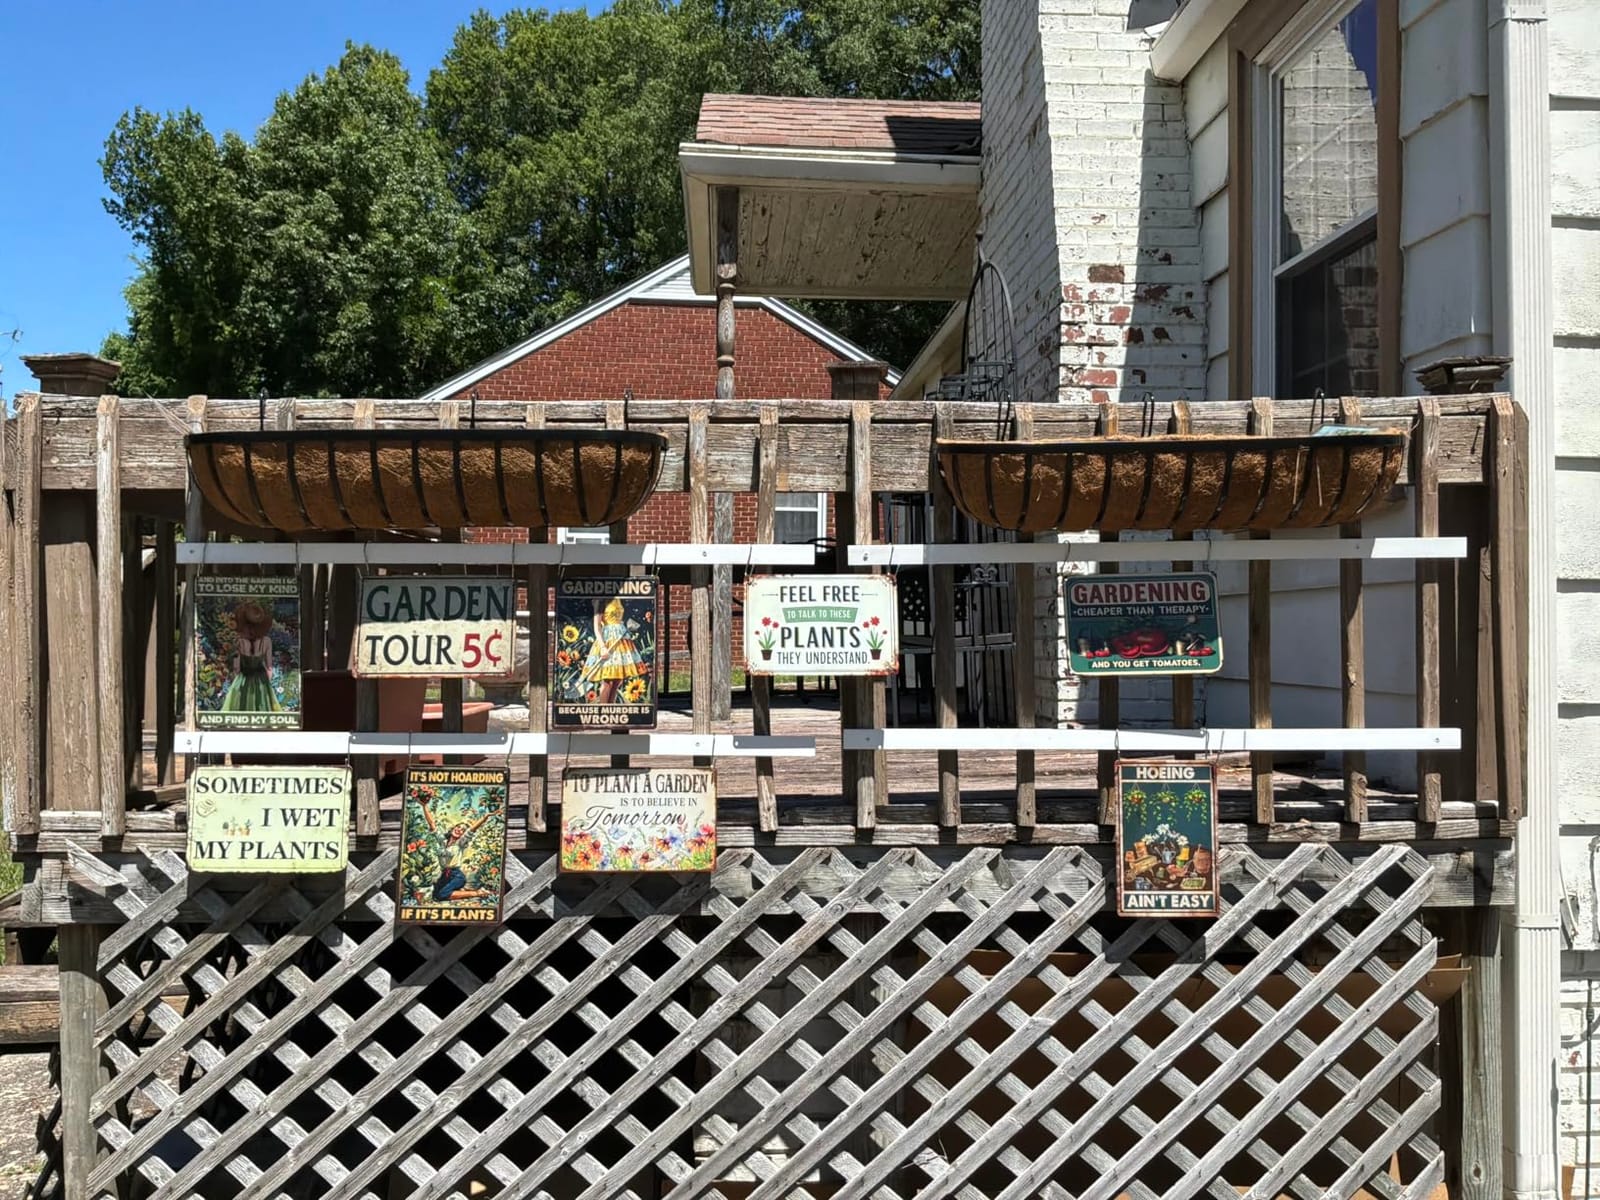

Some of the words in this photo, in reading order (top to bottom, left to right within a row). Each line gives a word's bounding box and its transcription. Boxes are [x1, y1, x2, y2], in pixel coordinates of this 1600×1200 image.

[198, 583, 214, 592] TO
[216, 583, 247, 593] LOSE
[248, 584, 266, 593] MY
[268, 585, 298, 593] KIND
[562, 581, 651, 594] GARDENING
[780, 585, 816, 603] FEEL
[823, 585, 860, 602] FREE
[1074, 582, 1206, 604] GARDENING
[366, 585, 510, 622] GARDEN
[1126, 605, 1155, 615] THAN
[787, 610, 796, 619] TO
[799, 609, 816, 619] TALK
[819, 609, 828, 618] TO
[830, 609, 851, 618] THESE
[780, 626, 861, 648] PLANTS
[365, 634, 455, 665] TOUR
[462, 629, 503, 668] 5¢
[777, 651, 801, 665] THEY
[806, 651, 871, 665] UNDERSTAND.
[1091, 661, 1110, 669] AND
[1113, 660, 1131, 668] YOU
[1133, 660, 1149, 668] GET
[1153, 659, 1201, 667] TOMATOES.
[558, 706, 599, 714] BECAUSE
[200, 715, 222, 724] AND
[225, 715, 249, 724] FIND
[250, 715, 267, 724] MY
[269, 716, 298, 724] SOUL
[580, 714, 629, 724] WRONG
[410, 771, 427, 782] IT'S
[428, 771, 449, 782] NOT
[451, 772, 504, 784] HOARDING
[1136, 767, 1195, 780] HOEING
[196, 776, 344, 795] SOMETIMES
[572, 773, 590, 793] TO
[595, 773, 640, 793] PLANT
[643, 773, 653, 793] A
[656, 773, 708, 793] GARDEN
[620, 797, 629, 807] IS
[632, 797, 644, 807] TO
[647, 797, 685, 807] BELIEVE
[688, 797, 698, 807] IN
[261, 807, 273, 827] I
[279, 807, 340, 827] WET
[580, 805, 686, 831] Tomorrow
[194, 840, 232, 860] MY
[238, 840, 340, 860] PLANTS
[1127, 895, 1169, 908] AIN'T
[1171, 894, 1211, 908] EASY
[401, 909, 414, 919] IF
[415, 909, 439, 919] IT'S
[441, 909, 495, 920] PLANTS
